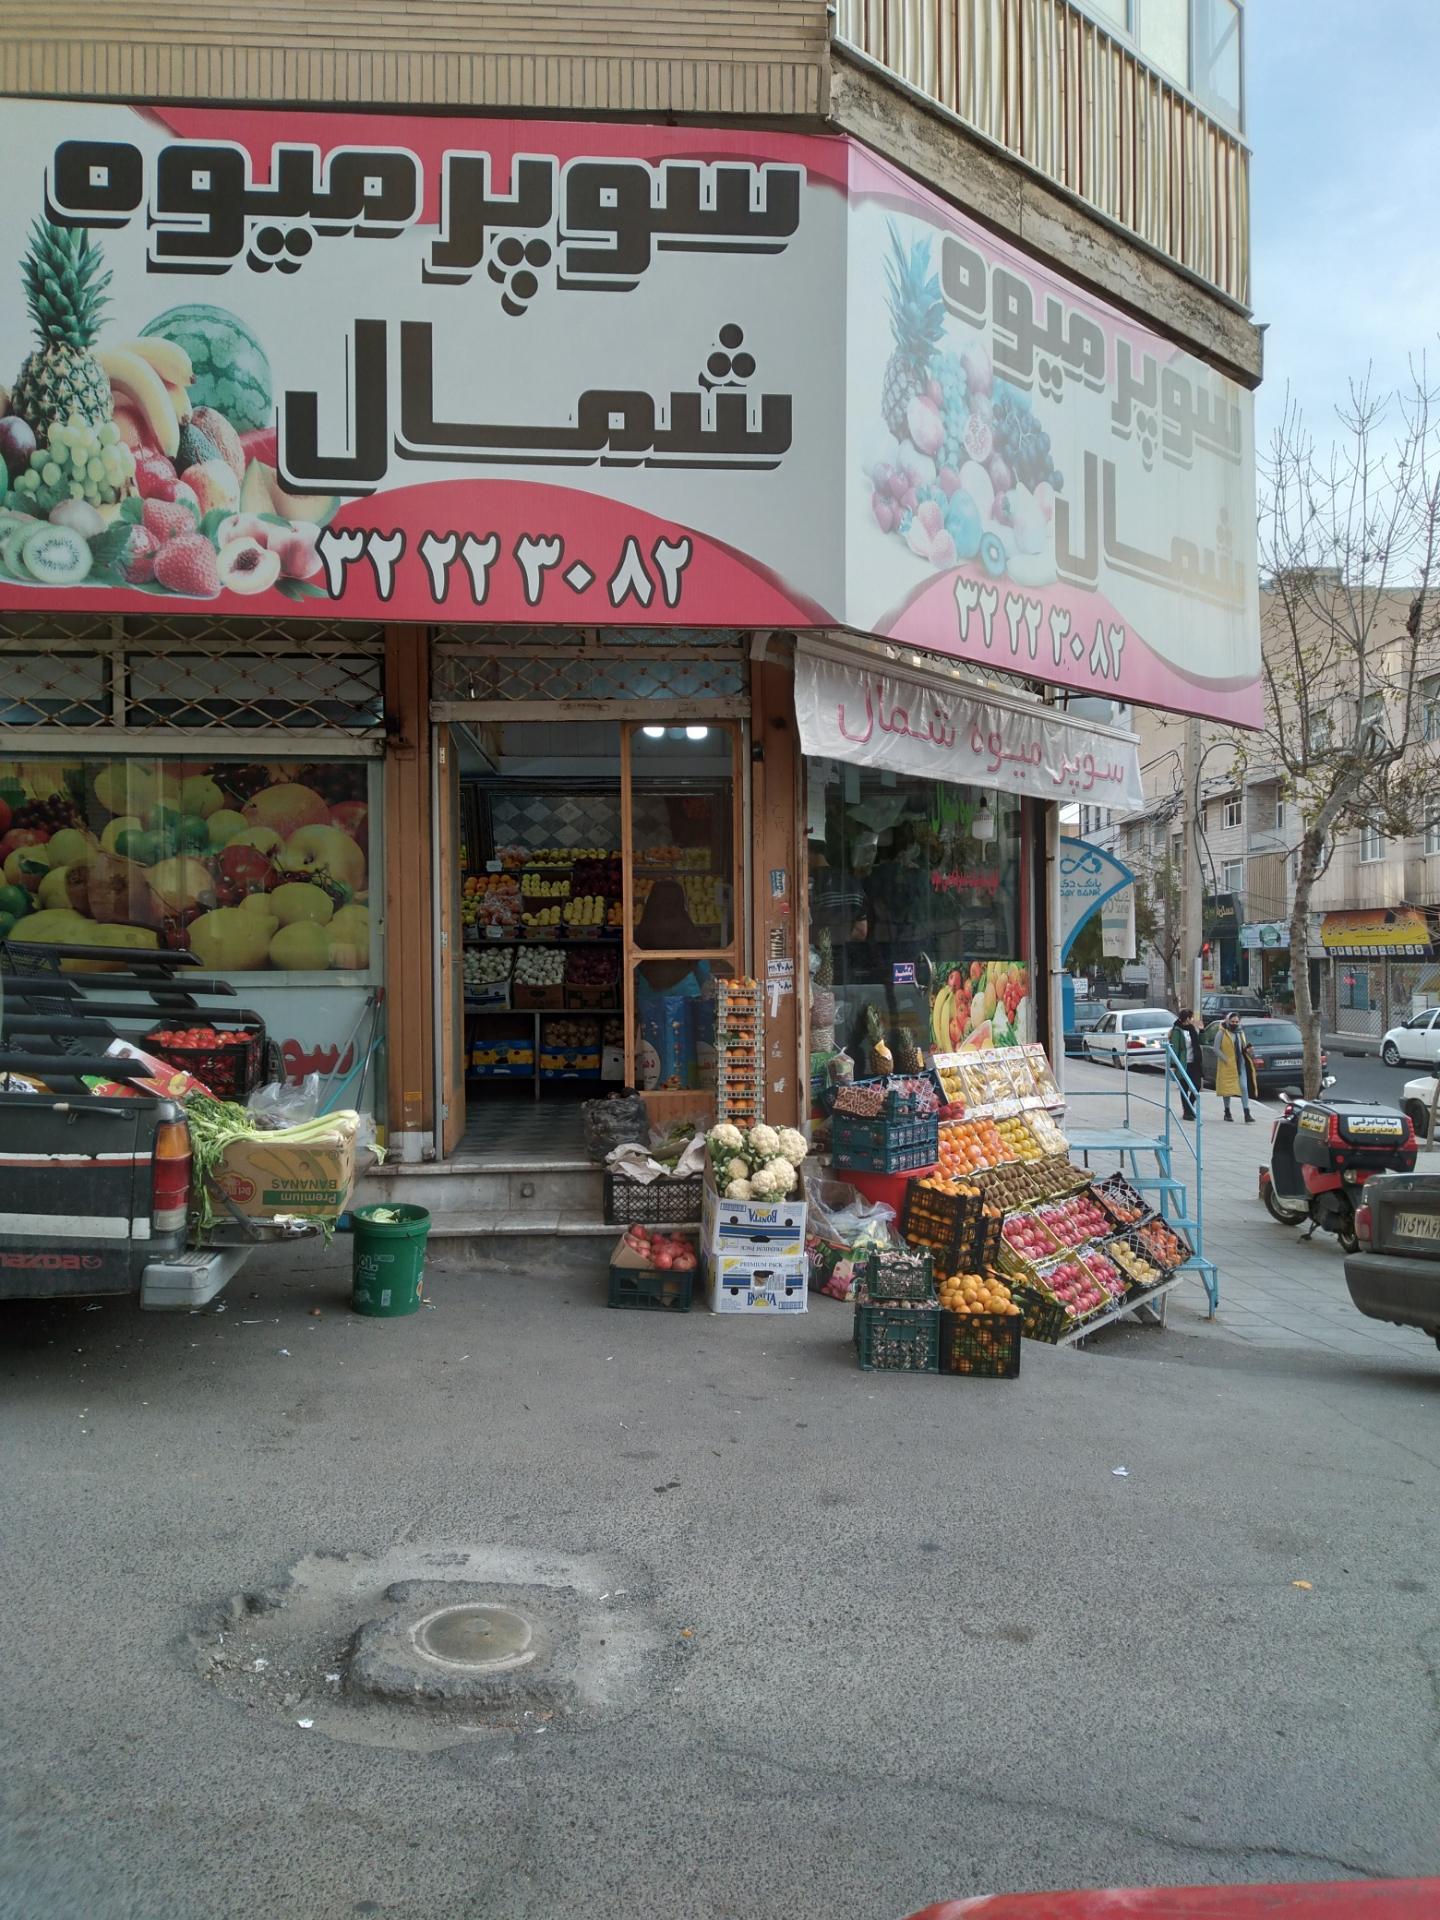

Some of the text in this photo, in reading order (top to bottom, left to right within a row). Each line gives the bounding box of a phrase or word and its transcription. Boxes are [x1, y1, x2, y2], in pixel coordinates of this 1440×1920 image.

[44, 139, 806, 317] سوپر میوه
[276, 318, 795, 497] شمال
[942, 234, 1245, 471] سوپر میوه
[1054, 451, 1248, 613] شمال
[838, 682, 1125, 795] سوپر میوه شمال
[271, 1178, 338, 1190] BANANAS
[280, 1192, 337, 1204] Premium
